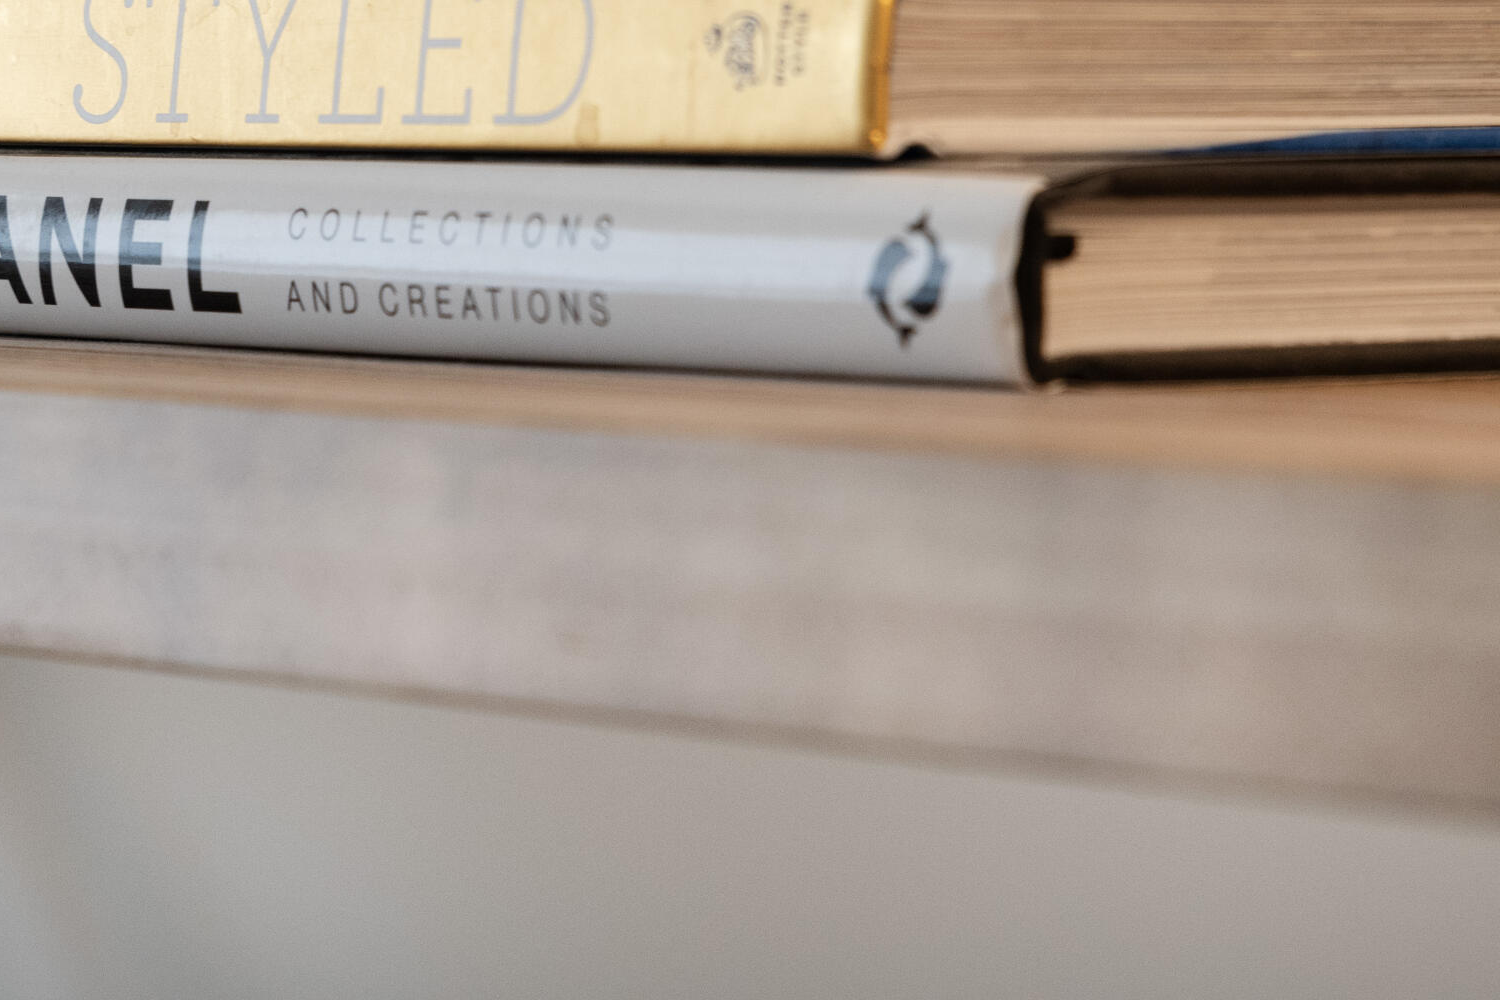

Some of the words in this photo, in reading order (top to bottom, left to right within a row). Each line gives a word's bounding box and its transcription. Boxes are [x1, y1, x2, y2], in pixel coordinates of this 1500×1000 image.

[287, 207, 615, 250] COLLECTIONS
[286, 280, 359, 314] AND
[378, 282, 612, 328] CREATIONS
